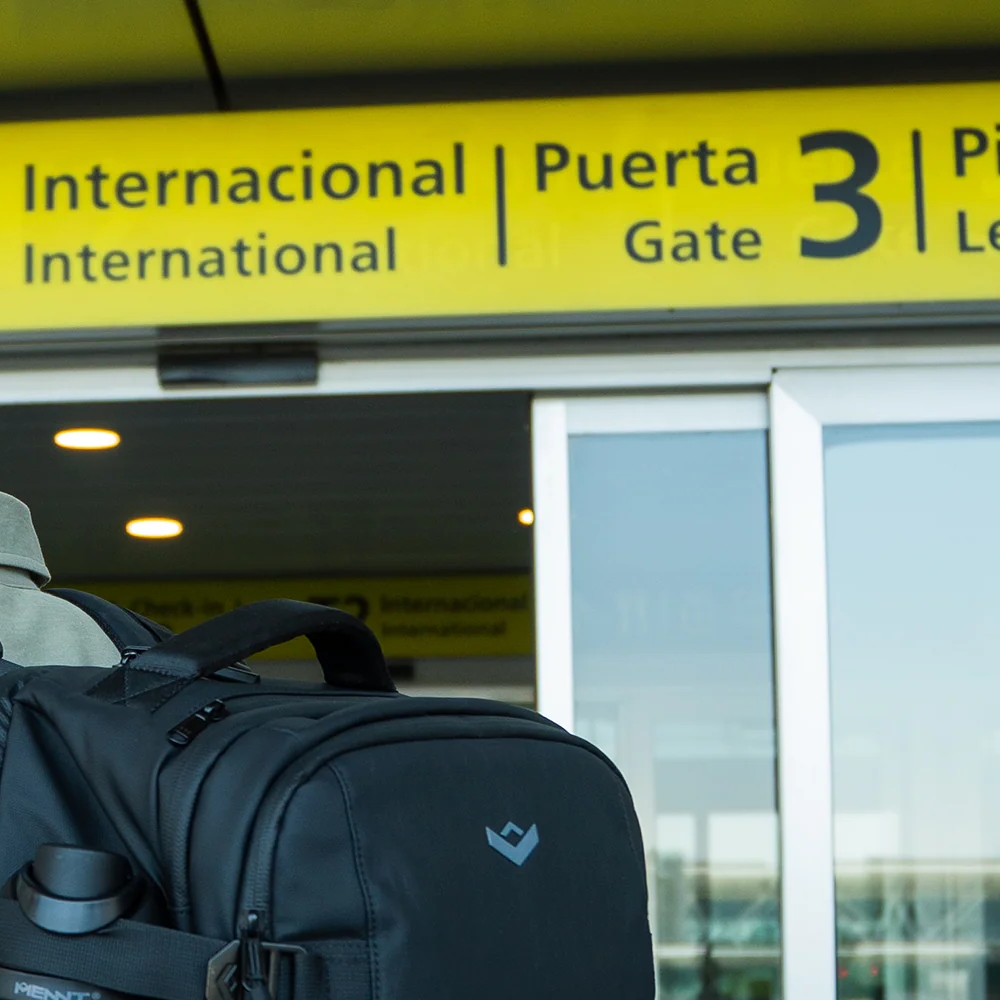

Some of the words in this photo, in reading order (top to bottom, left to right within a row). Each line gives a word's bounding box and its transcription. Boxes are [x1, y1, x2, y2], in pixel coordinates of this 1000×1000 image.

[24, 141, 464, 211] Internacional
[535, 140, 758, 192] Puerta
[799, 129, 883, 260] 3
[25, 226, 396, 284] International
[624, 219, 762, 264] Gate
